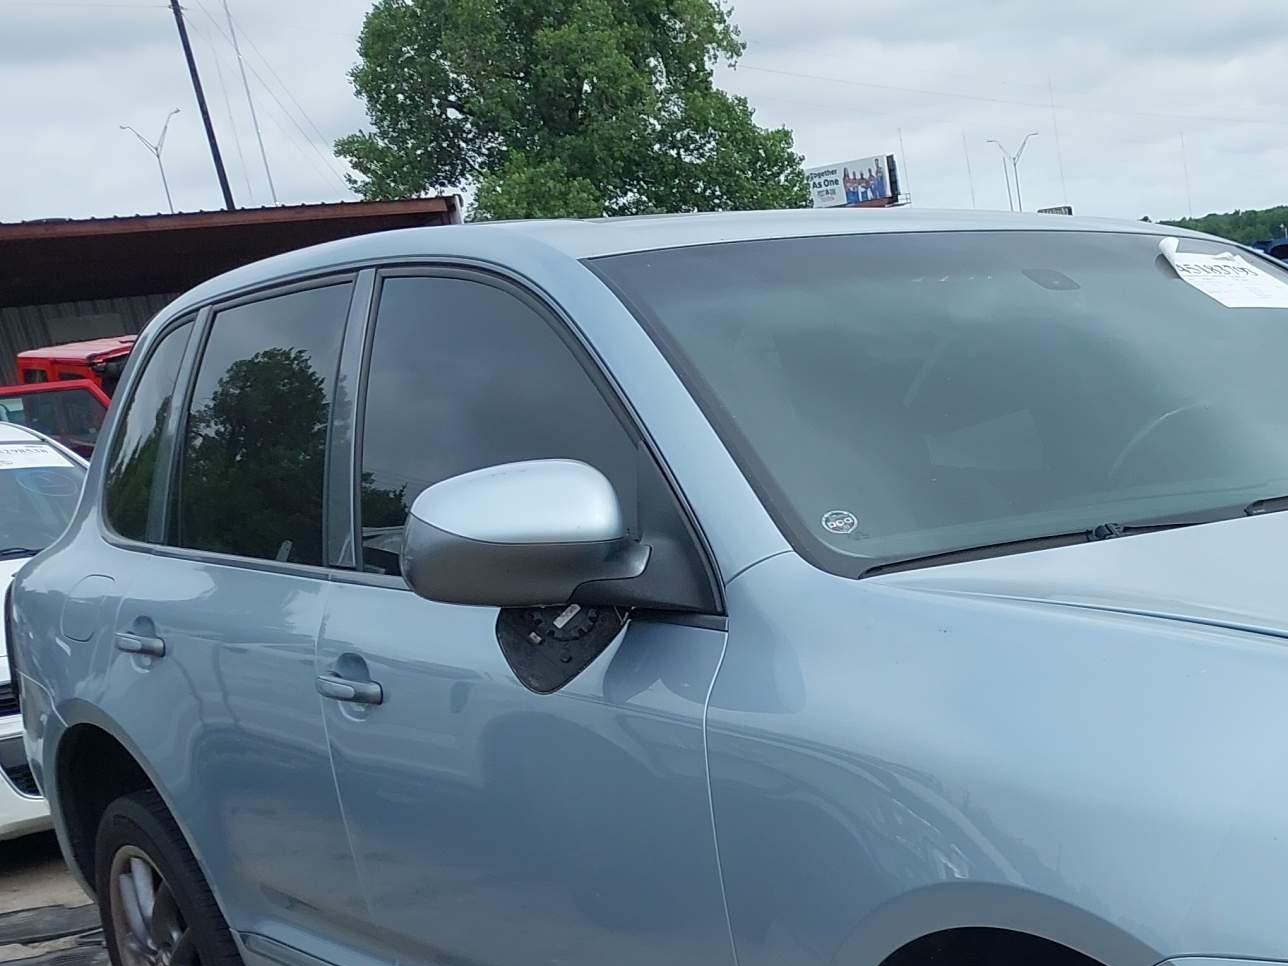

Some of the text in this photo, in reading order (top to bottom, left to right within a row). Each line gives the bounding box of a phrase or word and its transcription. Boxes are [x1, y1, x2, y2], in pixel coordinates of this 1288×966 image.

[809, 169, 838, 180] Together
[812, 178, 839, 189] As One
